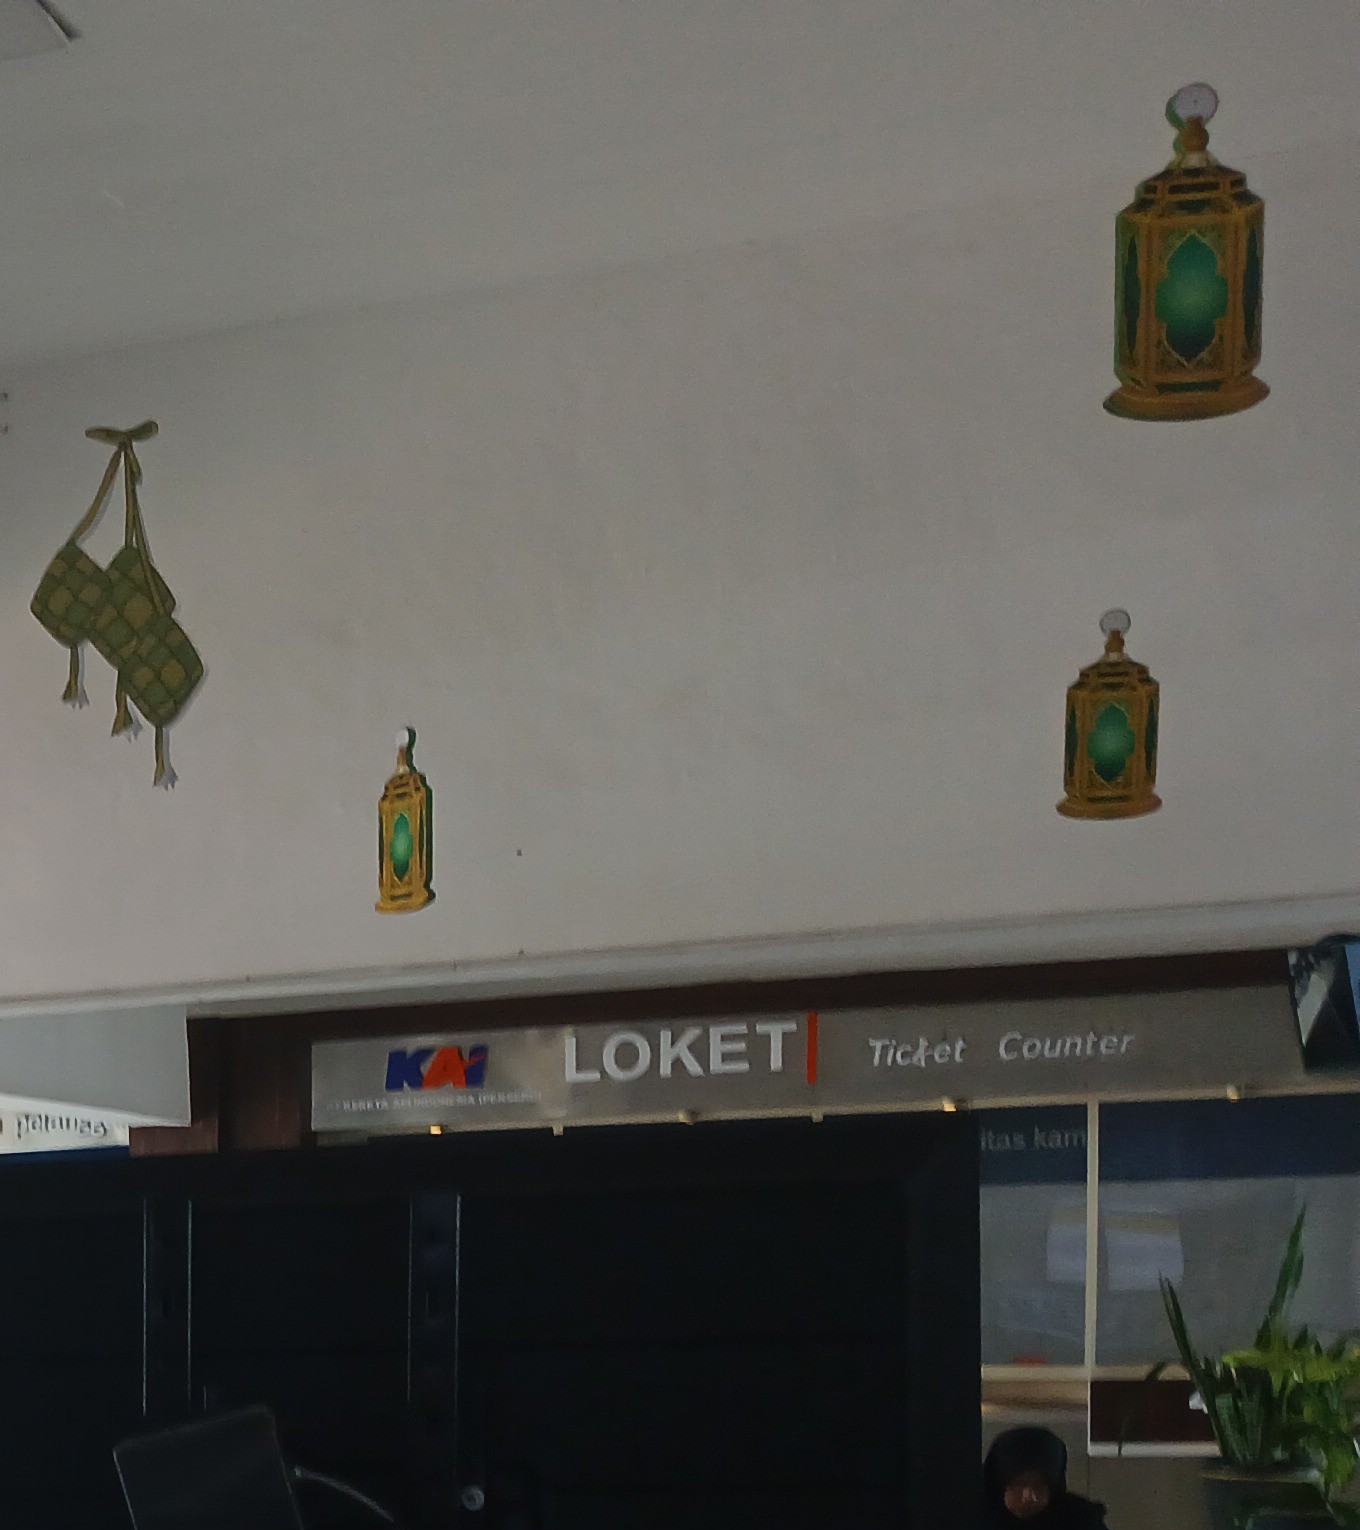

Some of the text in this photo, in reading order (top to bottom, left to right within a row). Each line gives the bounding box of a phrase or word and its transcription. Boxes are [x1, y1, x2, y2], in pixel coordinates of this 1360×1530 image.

[385, 1044, 489, 1092] KAI
[565, 1020, 797, 1083] LOKET
[868, 1030, 1136, 1068] Ticket Counter
